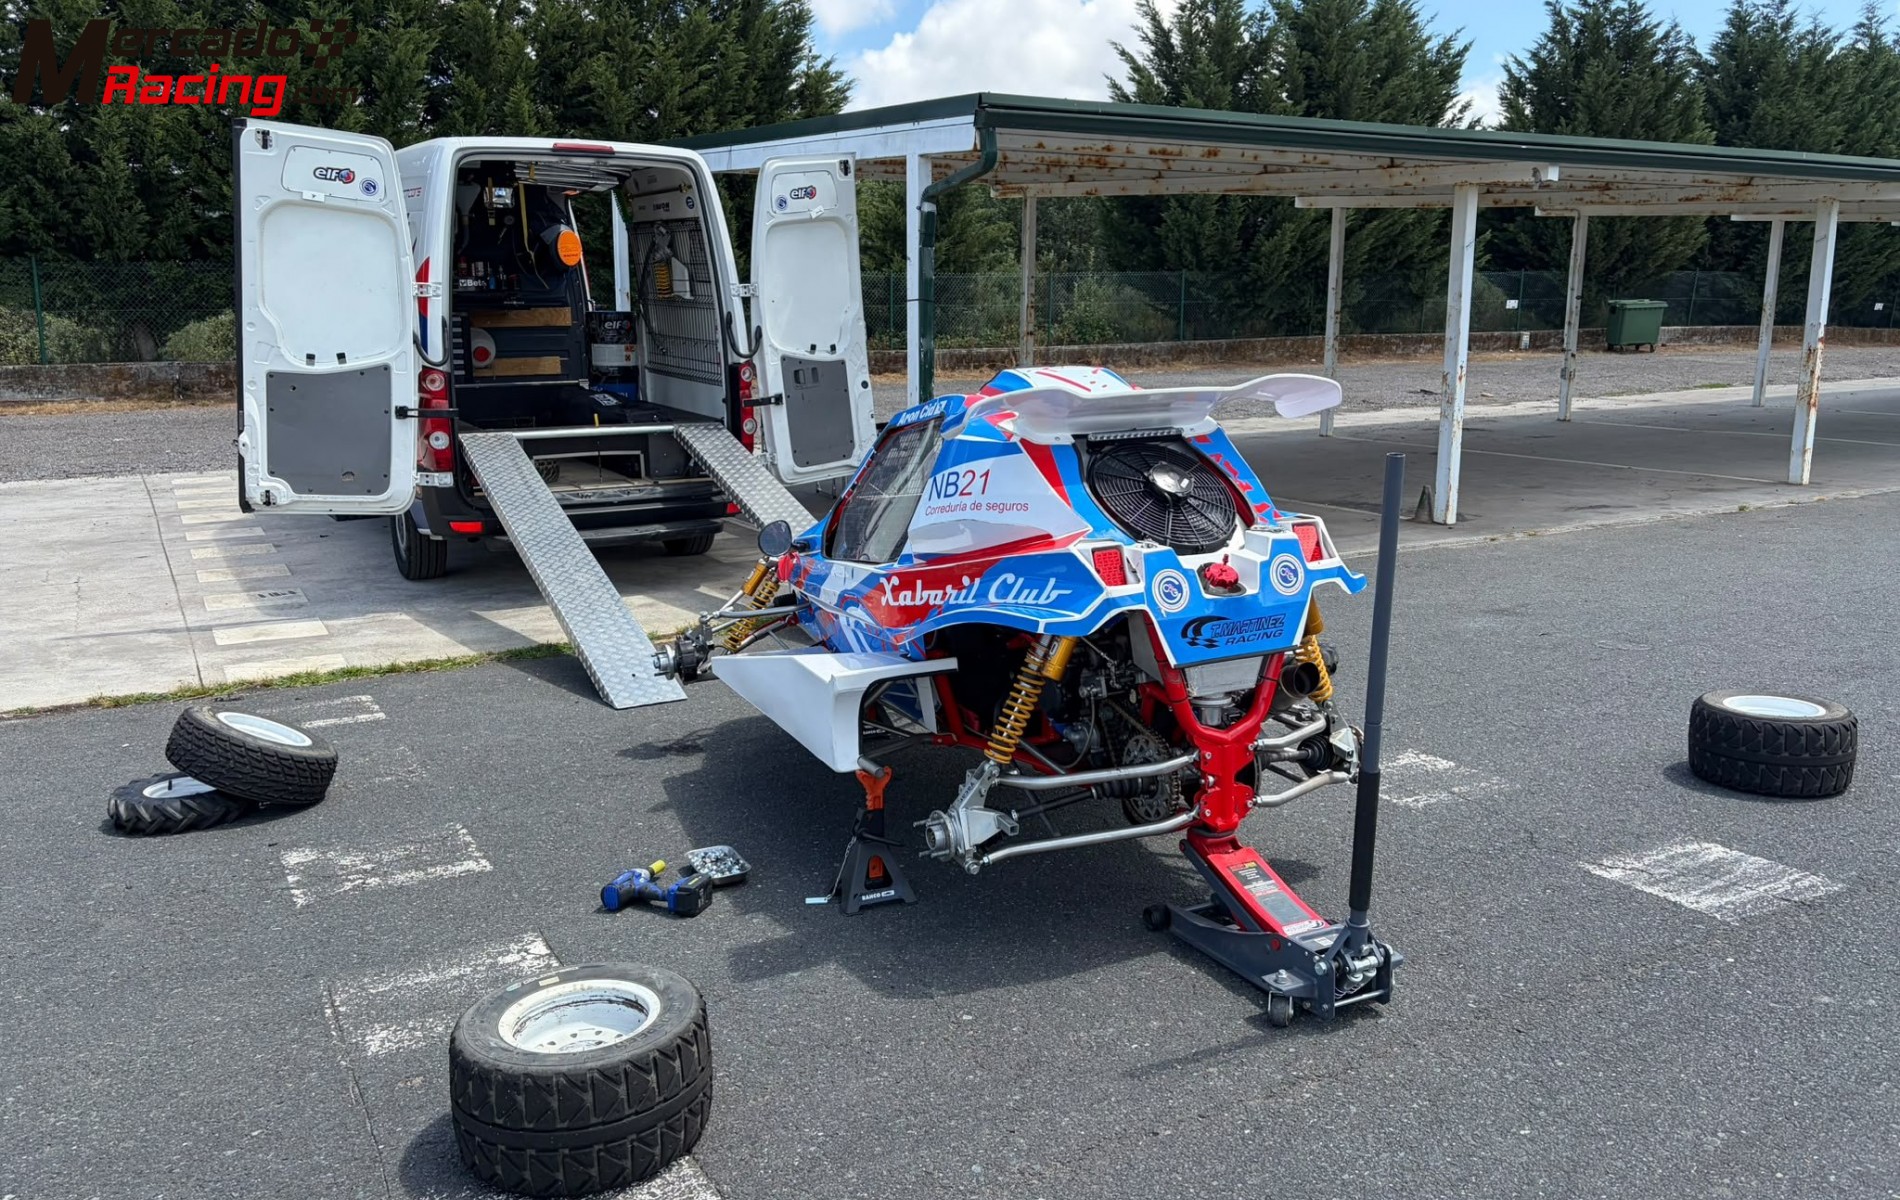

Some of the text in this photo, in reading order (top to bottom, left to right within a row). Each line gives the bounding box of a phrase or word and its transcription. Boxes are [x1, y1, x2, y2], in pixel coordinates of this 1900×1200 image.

[314, 166, 340, 182] elf
[928, 468, 992, 502] NB21
[925, 500, 1029, 516] Correduría de seguros
[880, 573, 1073, 607] Xabaril Club
[1225, 629, 1284, 646] RACING
